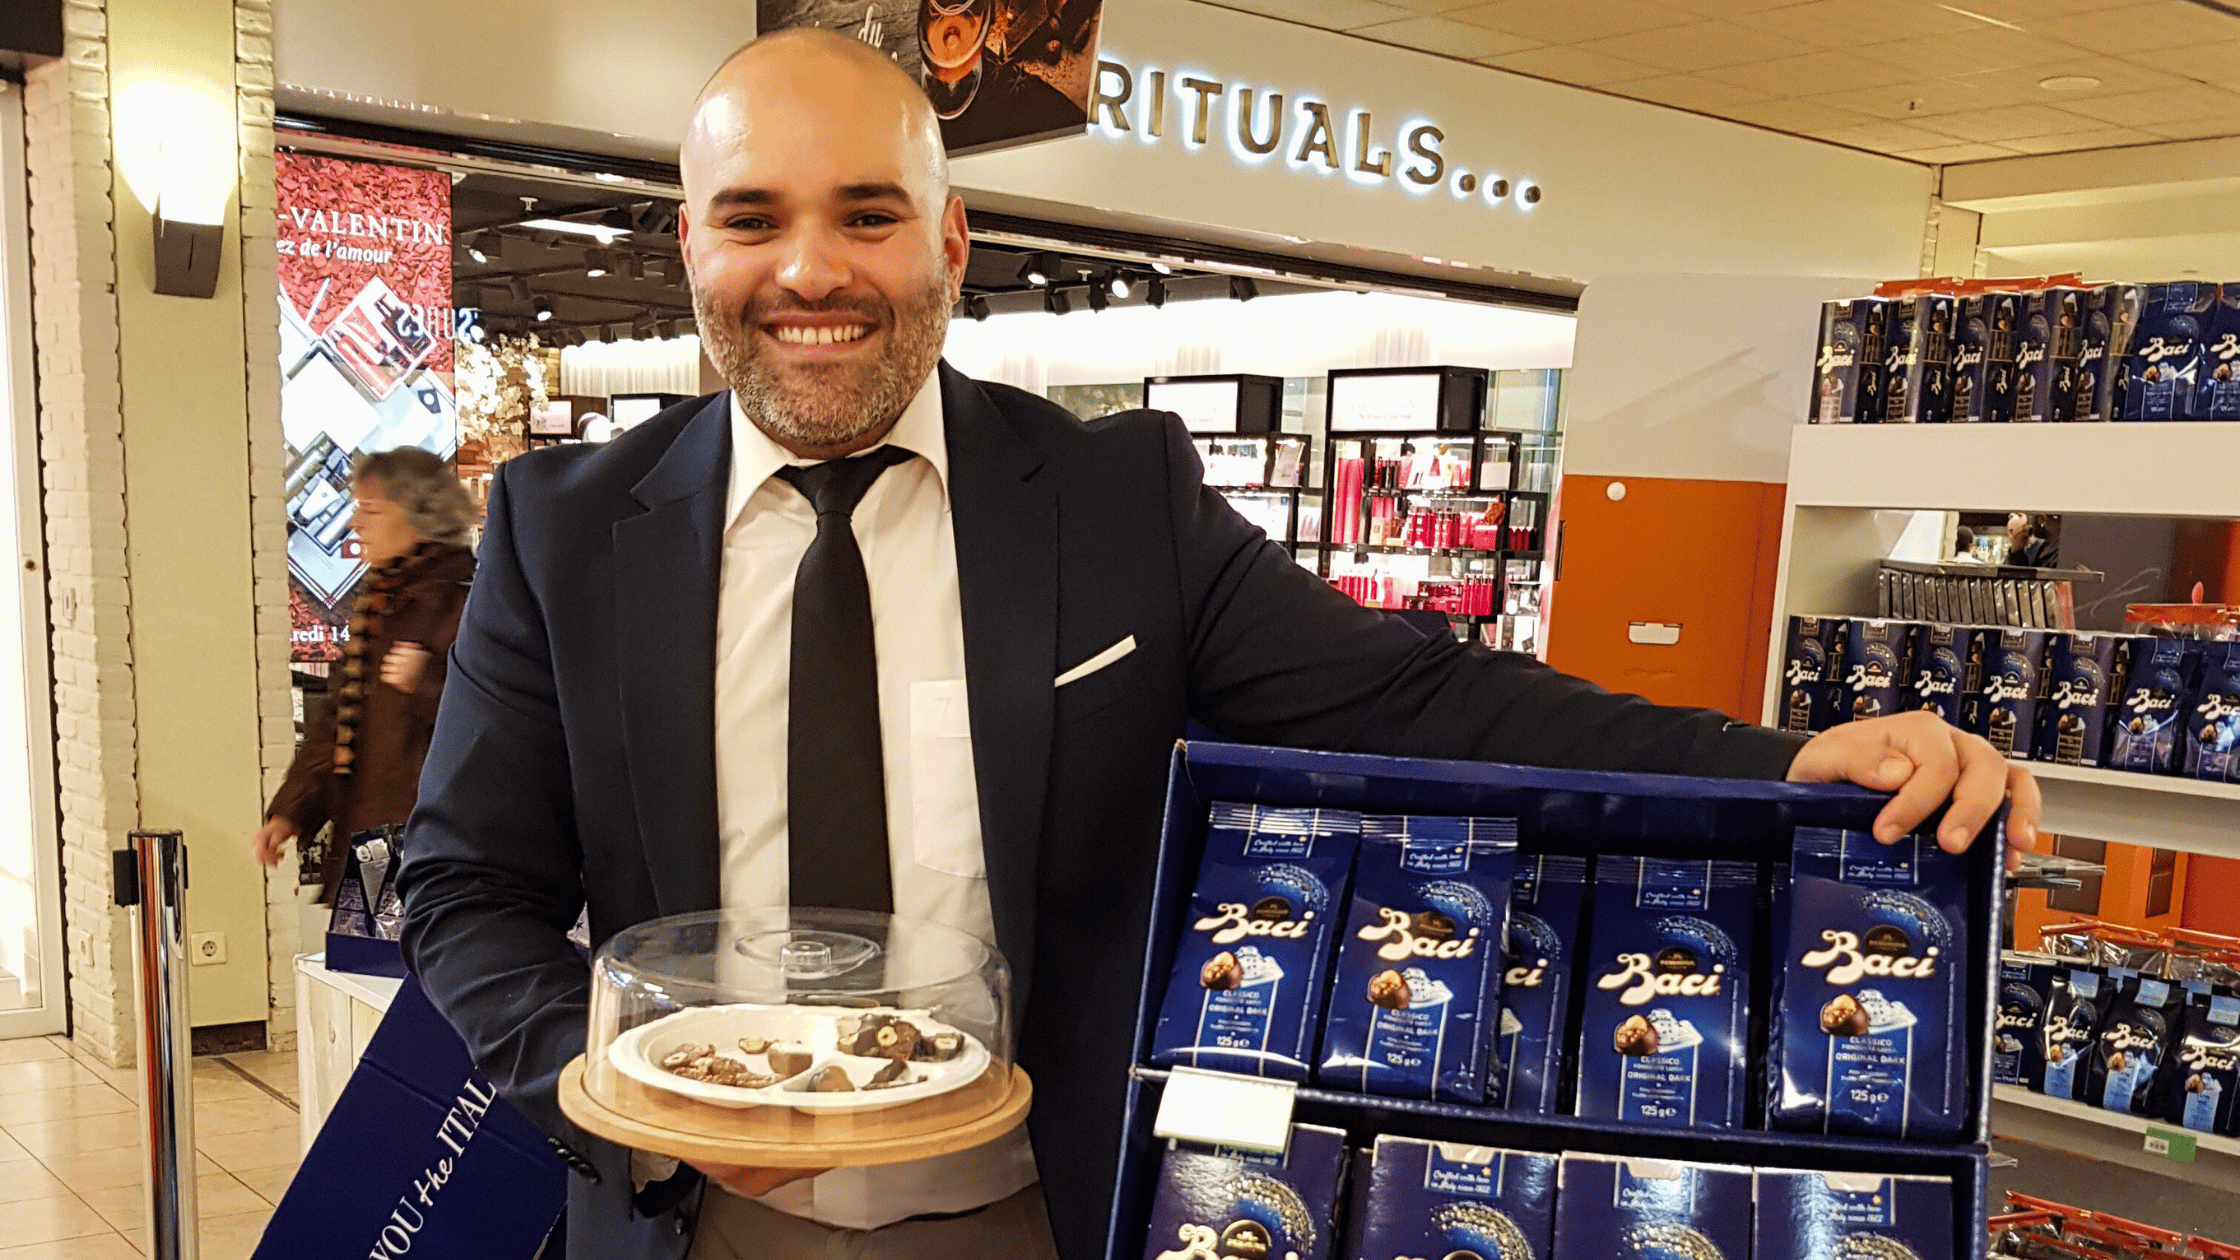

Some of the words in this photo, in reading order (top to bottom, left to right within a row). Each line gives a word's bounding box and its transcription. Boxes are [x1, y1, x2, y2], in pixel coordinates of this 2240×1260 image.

[1089, 60, 1542, 203] RITUALS...
[299, 238, 321, 257] de
[325, 239, 393, 264] l'amour
[1816, 346, 1855, 375] Baci
[1885, 345, 1919, 373] Baci
[1953, 345, 1984, 372] Baci
[2016, 341, 2046, 371] Baci
[2077, 338, 2106, 368] Baci
[2138, 337, 2193, 363] Baci
[289, 624, 325, 642] redi
[331, 625, 351, 642] 14
[1785, 659, 1822, 686] Baci
[1845, 664, 1893, 692] Baci
[1914, 669, 1956, 698] Baci
[1983, 675, 2030, 704] Baci
[2051, 680, 2099, 710] Baci
[2126, 687, 2175, 714] Baci
[1193, 903, 1315, 944] Baci
[1357, 907, 1480, 961] Baci
[1505, 957, 1548, 987] ci
[1801, 930, 1939, 985] Baci
[1597, 952, 1725, 1006] Baci
[2043, 1015, 2091, 1041] Baci
[2104, 1023, 2158, 1050] Baci
[2181, 1045, 2238, 1071] Baci
[1850, 1089, 1869, 1102] 125
[414, 1157, 453, 1207] the
